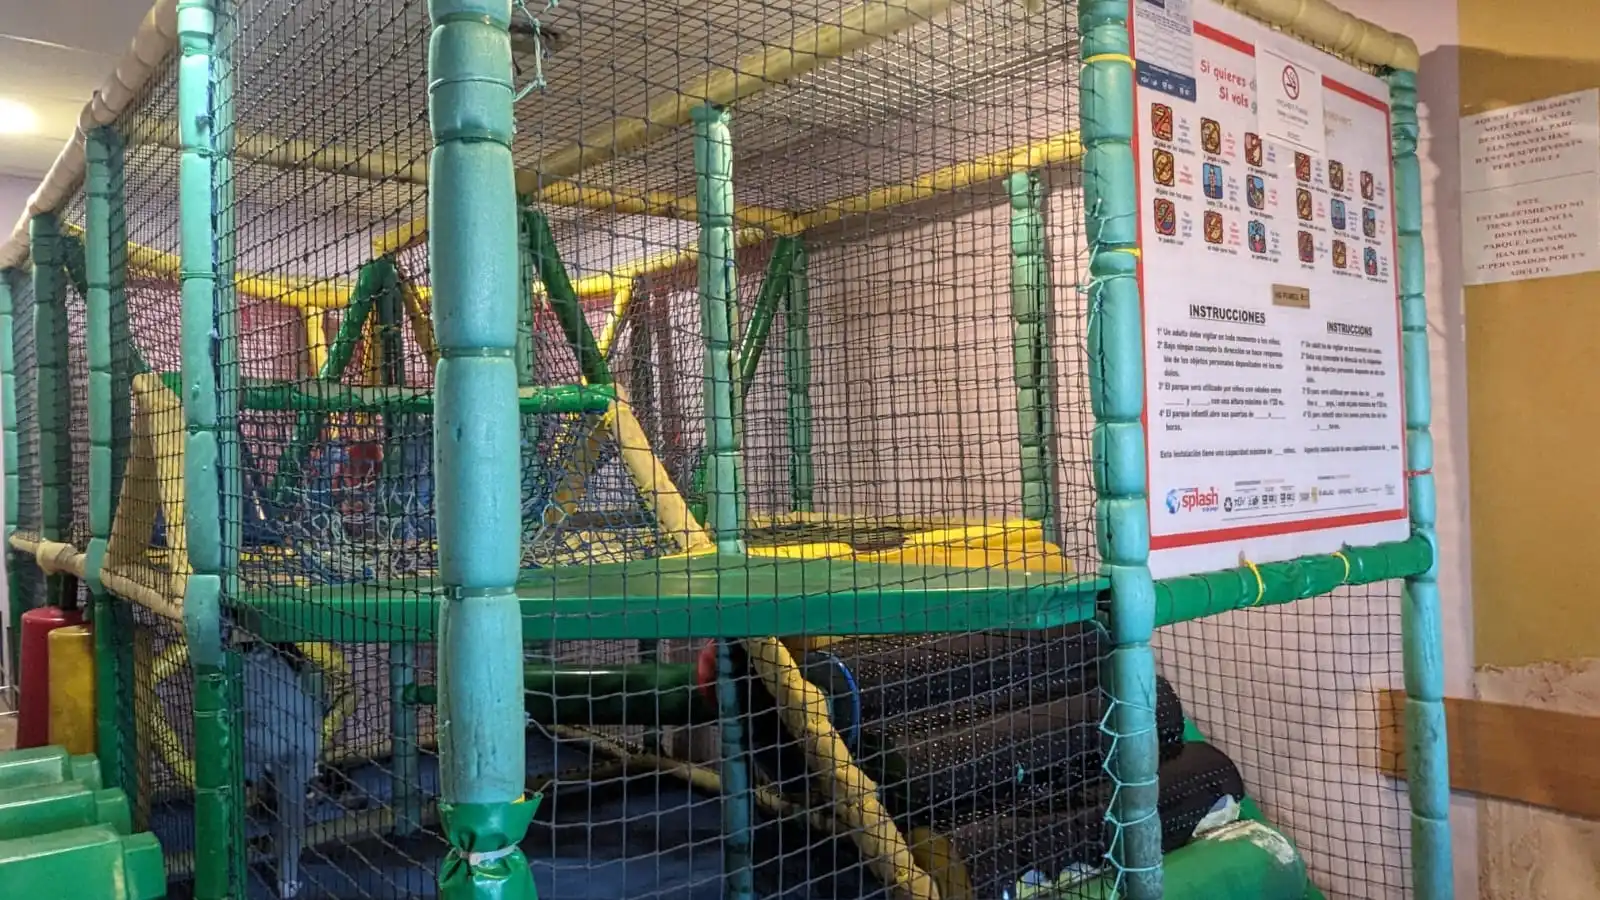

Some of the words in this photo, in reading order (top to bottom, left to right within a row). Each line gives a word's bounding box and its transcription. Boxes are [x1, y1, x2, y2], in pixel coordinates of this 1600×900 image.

[1200, 59, 1210, 73] Si
[1213, 67, 1246, 87] quieres
[1219, 86, 1229, 100] Si
[1231, 92, 1249, 108] vols
[1478, 129, 1532, 144] DESTINADA
[1476, 203, 1567, 222] ESTABLECIMIENTO
[1486, 221, 1512, 231] TIENE
[1515, 212, 1574, 227] VIGILANCIA
[1494, 226, 1548, 240] DESTINADA
[1517, 248, 1531, 256] DE
[1532, 244, 1565, 254] ESTAR
[1189, 303, 1266, 324] INSTRUCCIONES
[1326, 321, 1373, 336] INSTRUCCIONS
[1182, 486, 1218, 512] splash
